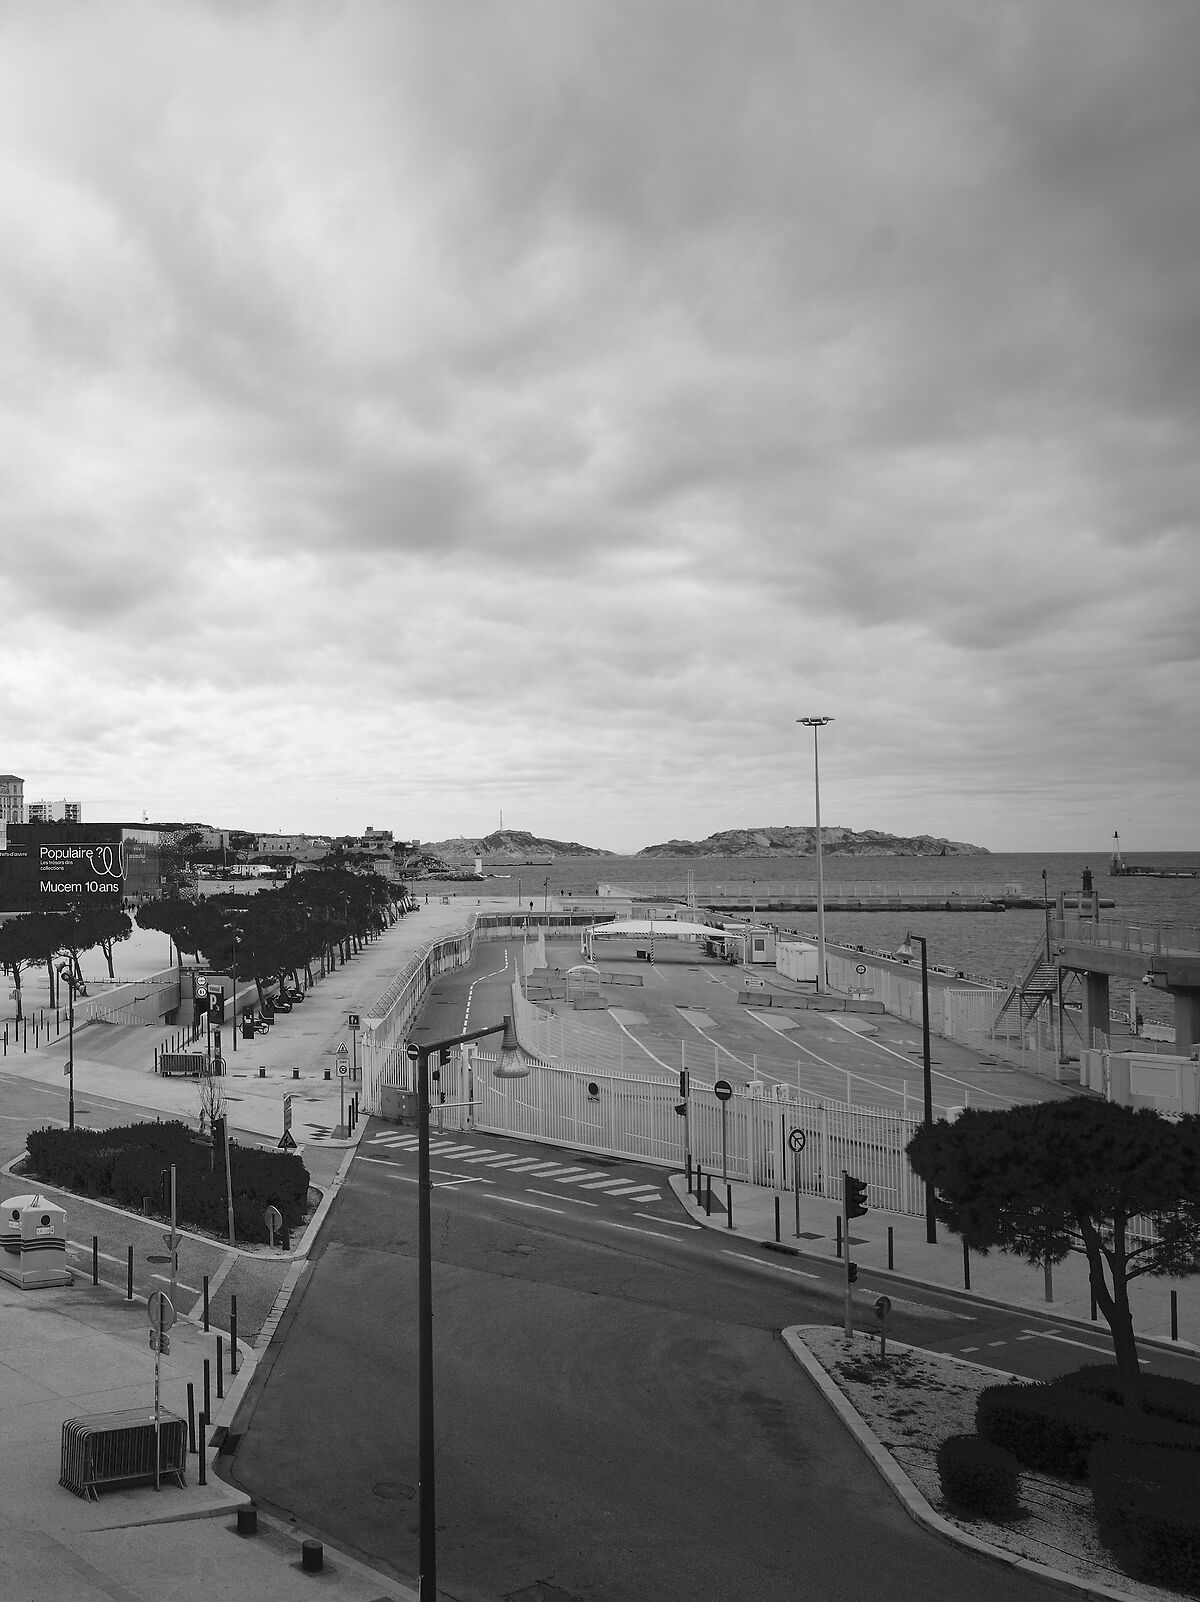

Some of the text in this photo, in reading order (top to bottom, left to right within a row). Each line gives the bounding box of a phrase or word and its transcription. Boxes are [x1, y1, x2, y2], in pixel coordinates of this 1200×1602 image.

[40, 847, 93, 860] Populaire
[40, 881, 119, 892] Mucem 10 ans
[210, 994, 217, 1010] P
